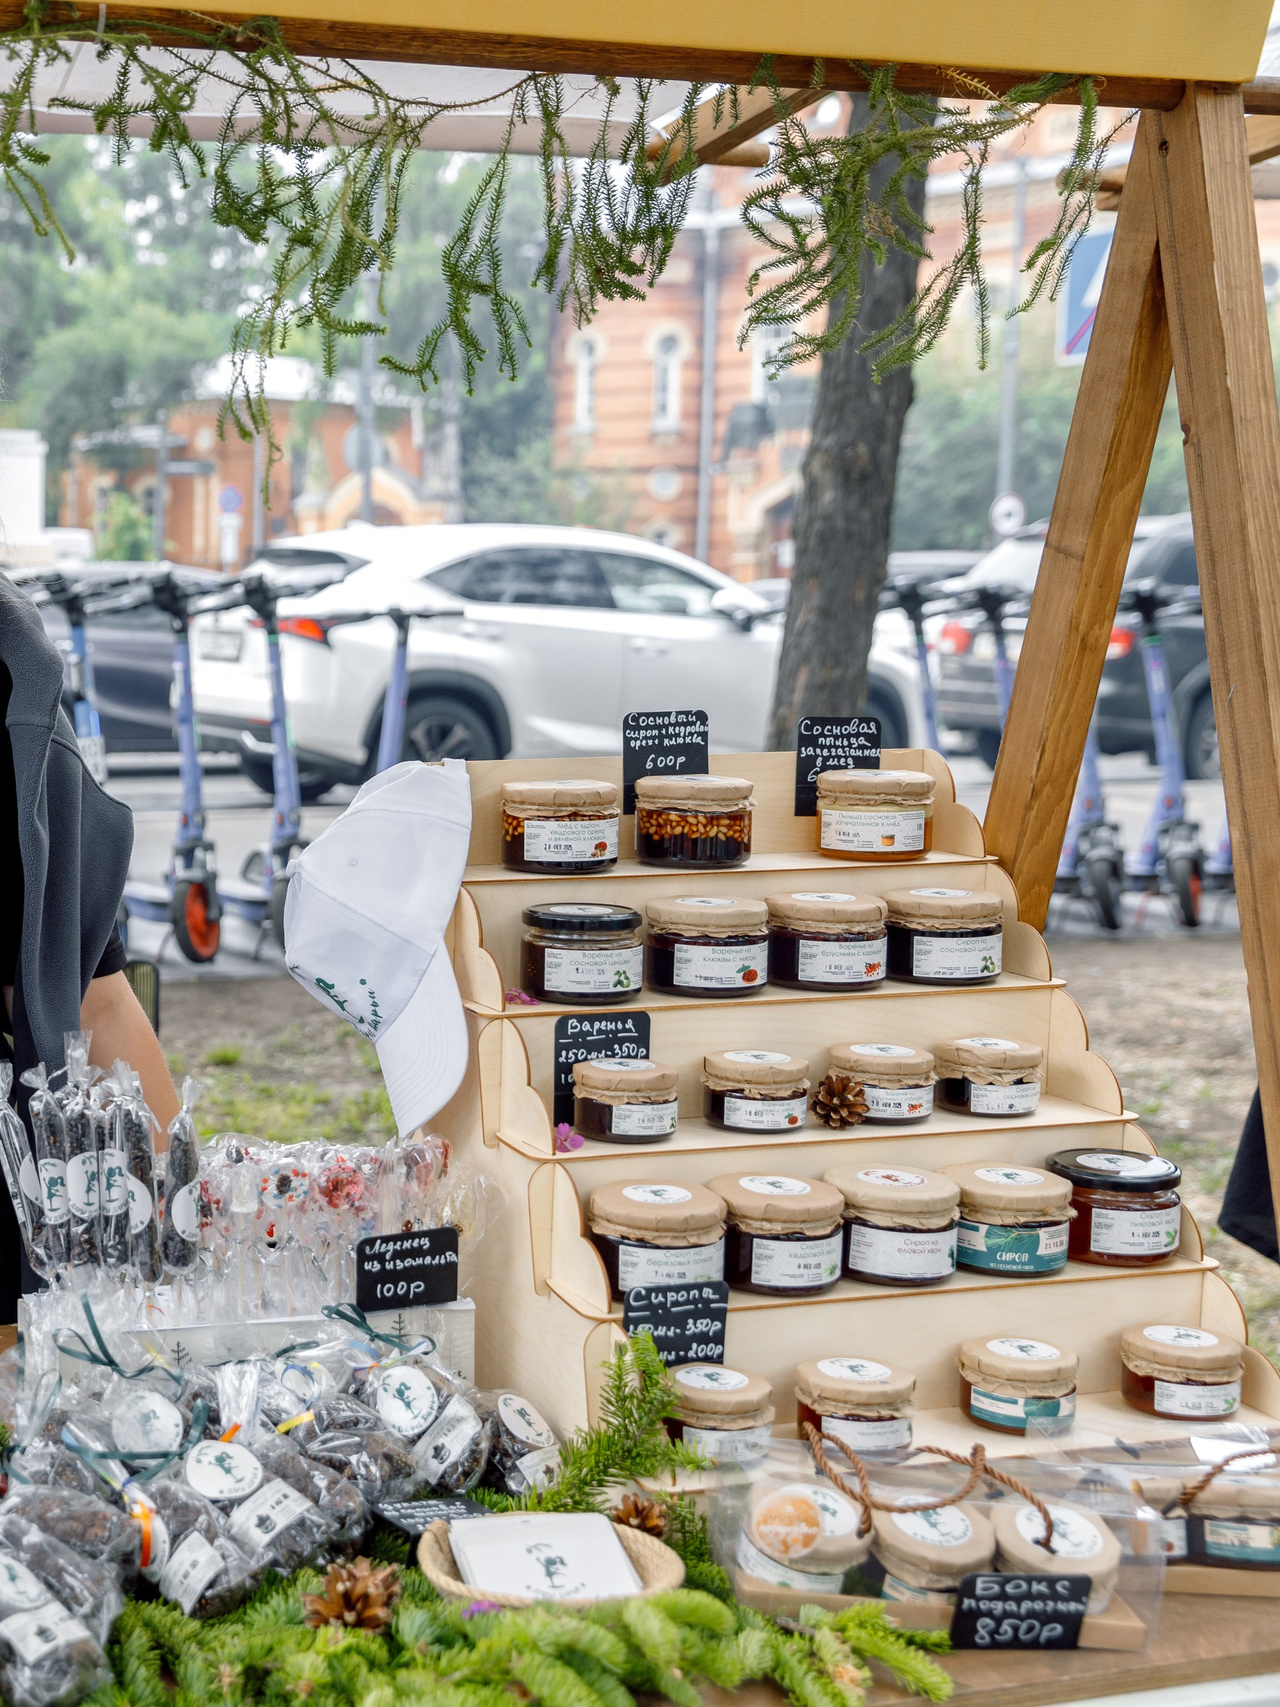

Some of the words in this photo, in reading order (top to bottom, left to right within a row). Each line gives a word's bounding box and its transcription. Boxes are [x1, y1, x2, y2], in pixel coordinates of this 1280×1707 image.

[628, 710, 697, 726] Сосновый
[801, 718, 878, 735] Сосновая
[625, 729, 659, 743] сироп
[664, 734, 705, 747] клюква
[818, 736, 872, 748] пыльца
[645, 754, 686, 770] 600р
[556, 822, 573, 830] Мёд
[580, 822, 600, 831] ядром
[835, 820, 880, 828] запечатанная
[550, 829, 584, 838] кедрового
[585, 828, 605, 836] ореха
[956, 938, 979, 947] Сироп
[581, 951, 613, 959] Варенье
[711, 947, 740, 955] Варенье
[821, 949, 856, 957] брусники
[939, 946, 976, 954] сосновой
[569, 959, 607, 967] сосновой
[608, 959, 631, 967] шишки
[702, 955, 732, 964] клюквы
[738, 955, 757, 963] мятой
[567, 1018, 636, 1036] Варенья
[1140, 1211, 1164, 1220] Сироп
[1130, 1220, 1164, 1228] пихтовой
[800, 1242, 824, 1252] Сироп
[903, 1238, 928, 1248] Сироп
[365, 1237, 431, 1260] Леденец
[897, 1246, 924, 1255] еловой
[663, 1249, 690, 1259] Сироп
[788, 1250, 823, 1259] кедровой
[996, 1251, 1029, 1263] СИРОП
[363, 1260, 381, 1273] из
[646, 1258, 690, 1267] березовых
[692, 1256, 713, 1265] почках
[376, 1281, 426, 1299] 100р
[629, 1287, 720, 1307] Сиропы
[974, 1616, 1065, 1647] 850р
